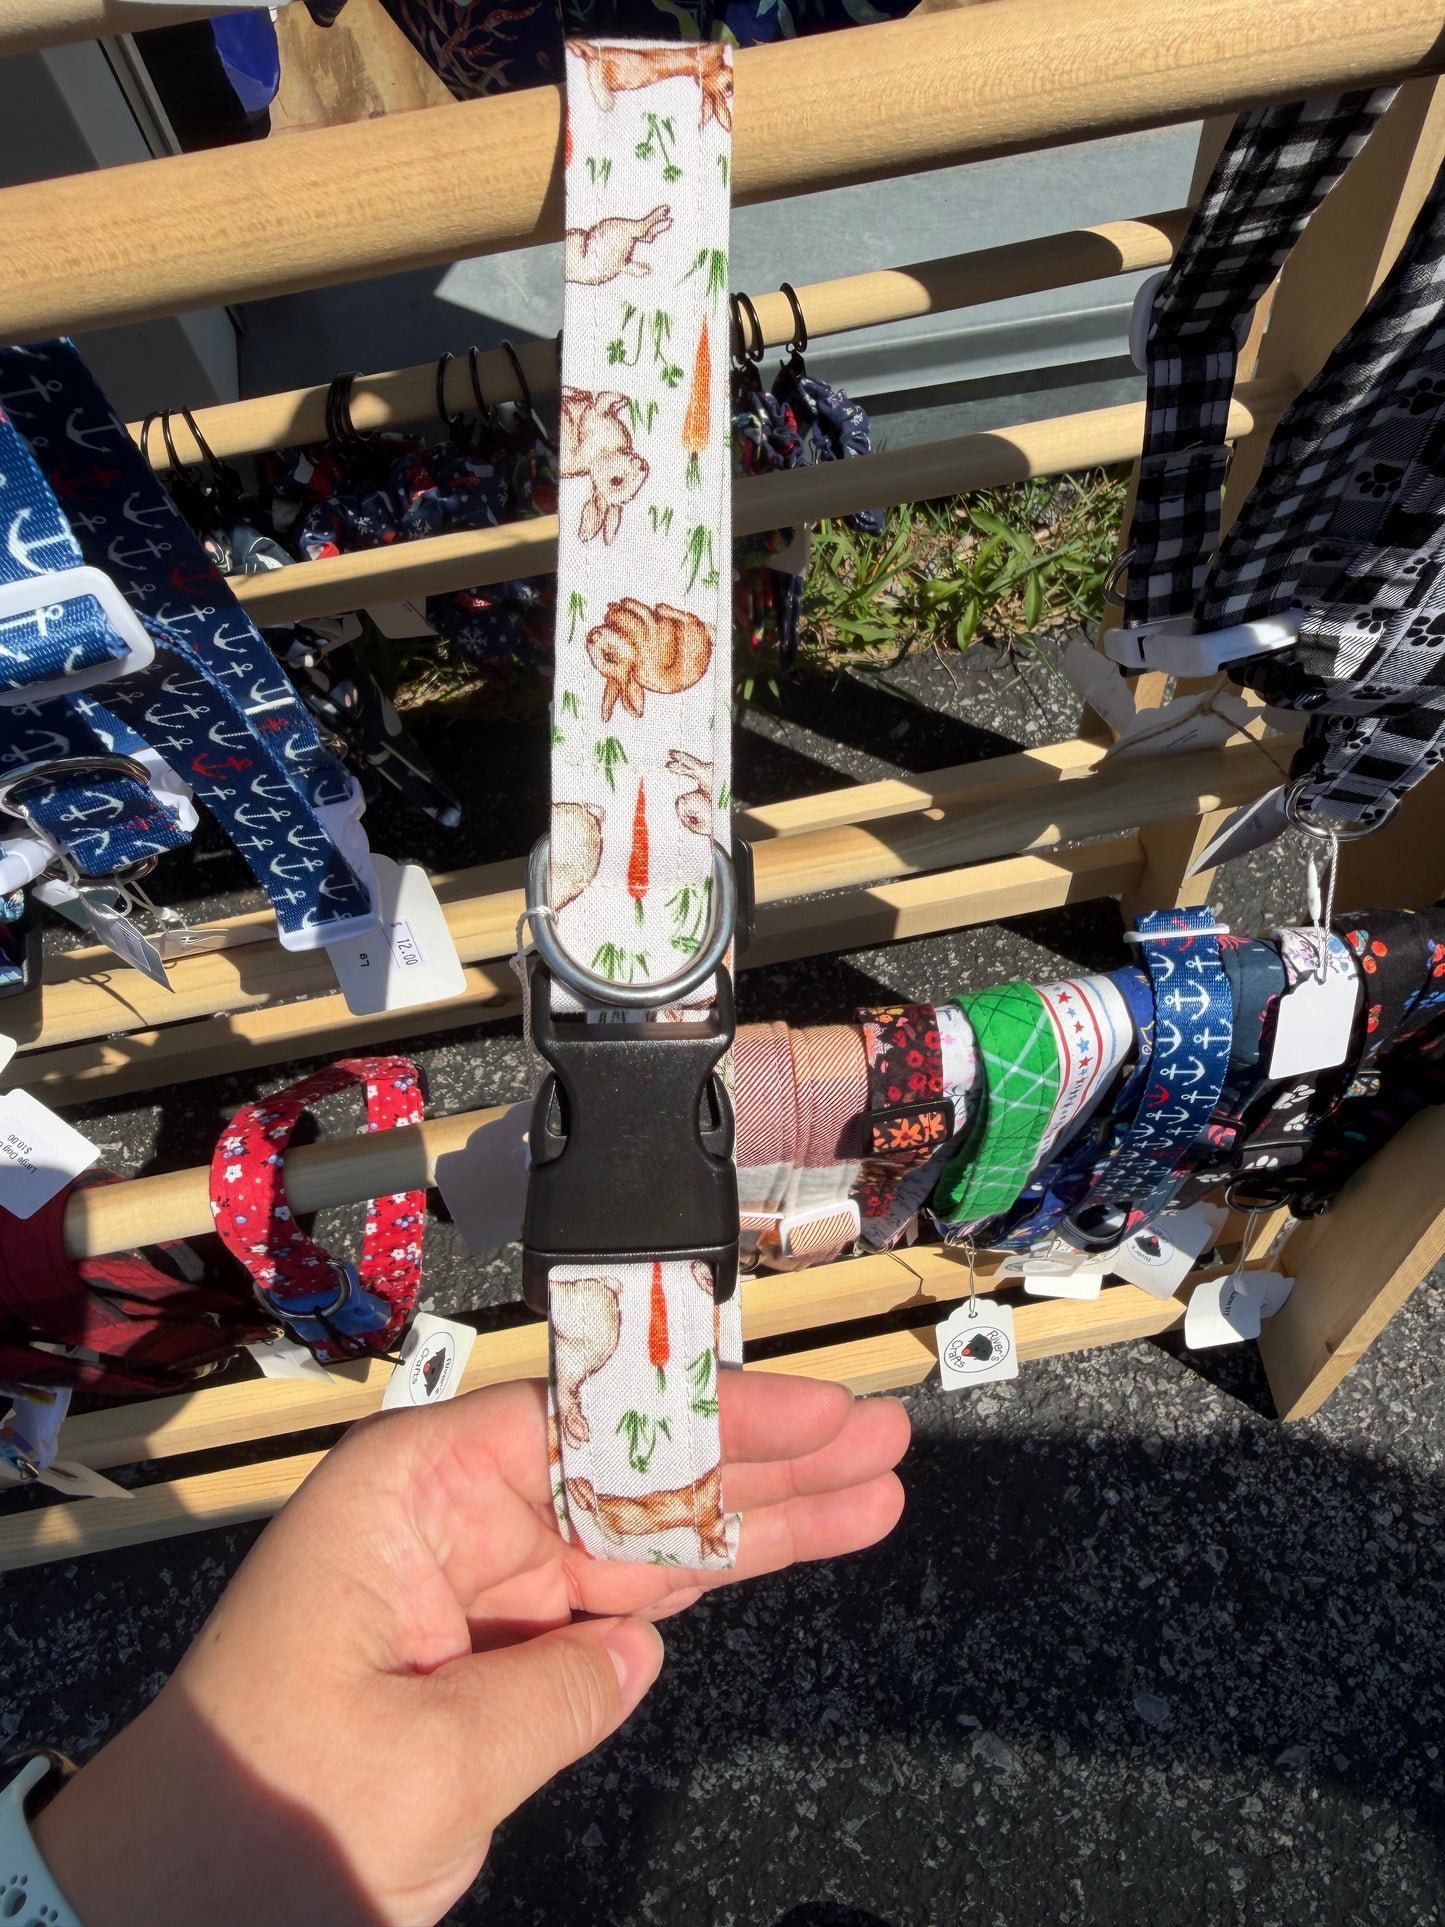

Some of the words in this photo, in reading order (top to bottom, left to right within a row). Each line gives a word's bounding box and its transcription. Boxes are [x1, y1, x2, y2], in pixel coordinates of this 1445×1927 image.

[397, 938, 418, 966] 12.00
[3, 1144, 19, 1160] Dog
[7, 1134, 33, 1155] $10.00
[17, 1156, 38, 1175] Large
[948, 1340, 966, 1369] Crafts
[986, 1330, 1004, 1362] River's
